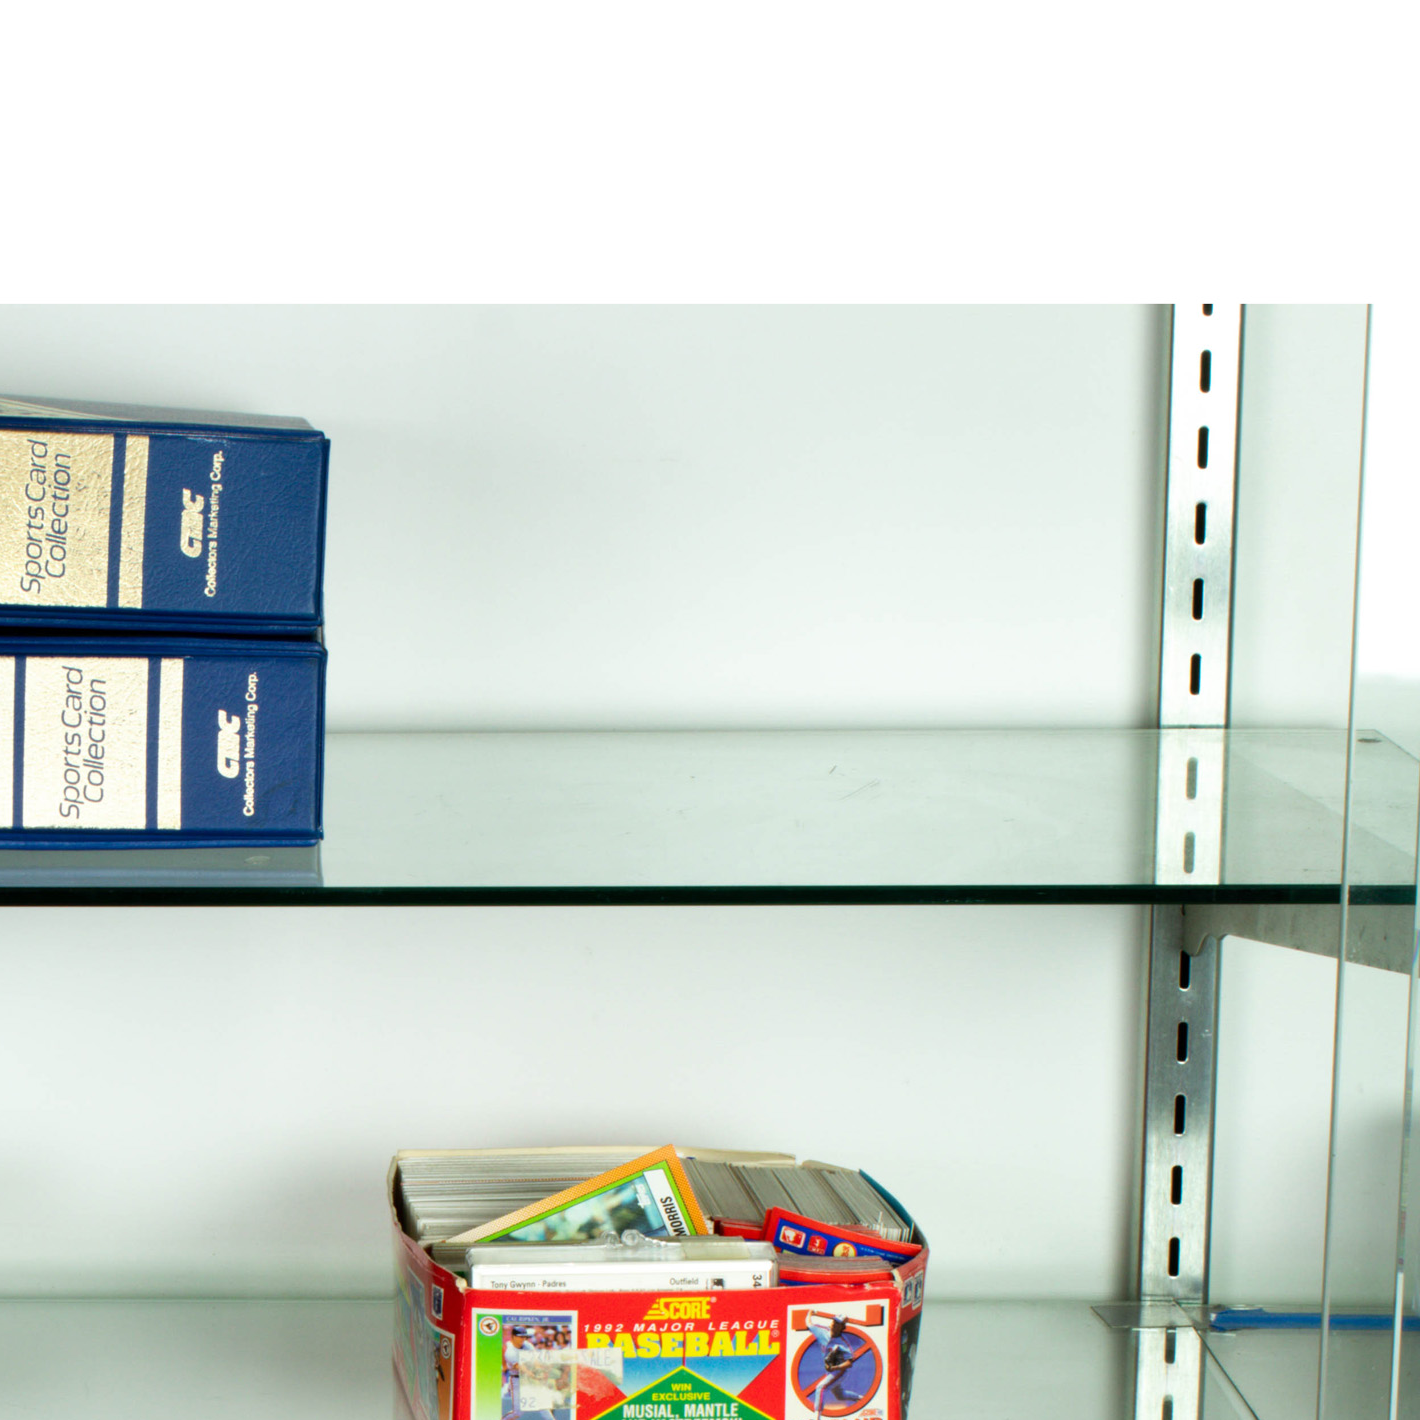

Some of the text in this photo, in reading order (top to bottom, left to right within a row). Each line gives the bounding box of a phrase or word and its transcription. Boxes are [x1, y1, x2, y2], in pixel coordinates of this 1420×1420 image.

[20, 439, 48, 594] Sports Card
[45, 453, 71, 578] Collection
[204, 451, 225, 597] Collectors Marketing Corp.
[59, 666, 84, 819] Sports Card
[83, 678, 106, 802] Collection
[243, 672, 259, 817] Collectors Marketing Corp.
[660, 1196, 691, 1237] MORRIS
[490, 1280, 508, 1290] Tony
[509, 1280, 536, 1290] Gwynn
[542, 1280, 567, 1288] Padres
[669, 1277, 699, 1286] Outfield
[643, 1296, 711, 1320] SCORE
[584, 1320, 780, 1333] 1992 MAJOR LEAGUE
[652, 1392, 710, 1401] EXCLUSIVE
[671, 1383, 691, 1391] WIN
[623, 1403, 738, 1420] MUSIAL, MANTLE
